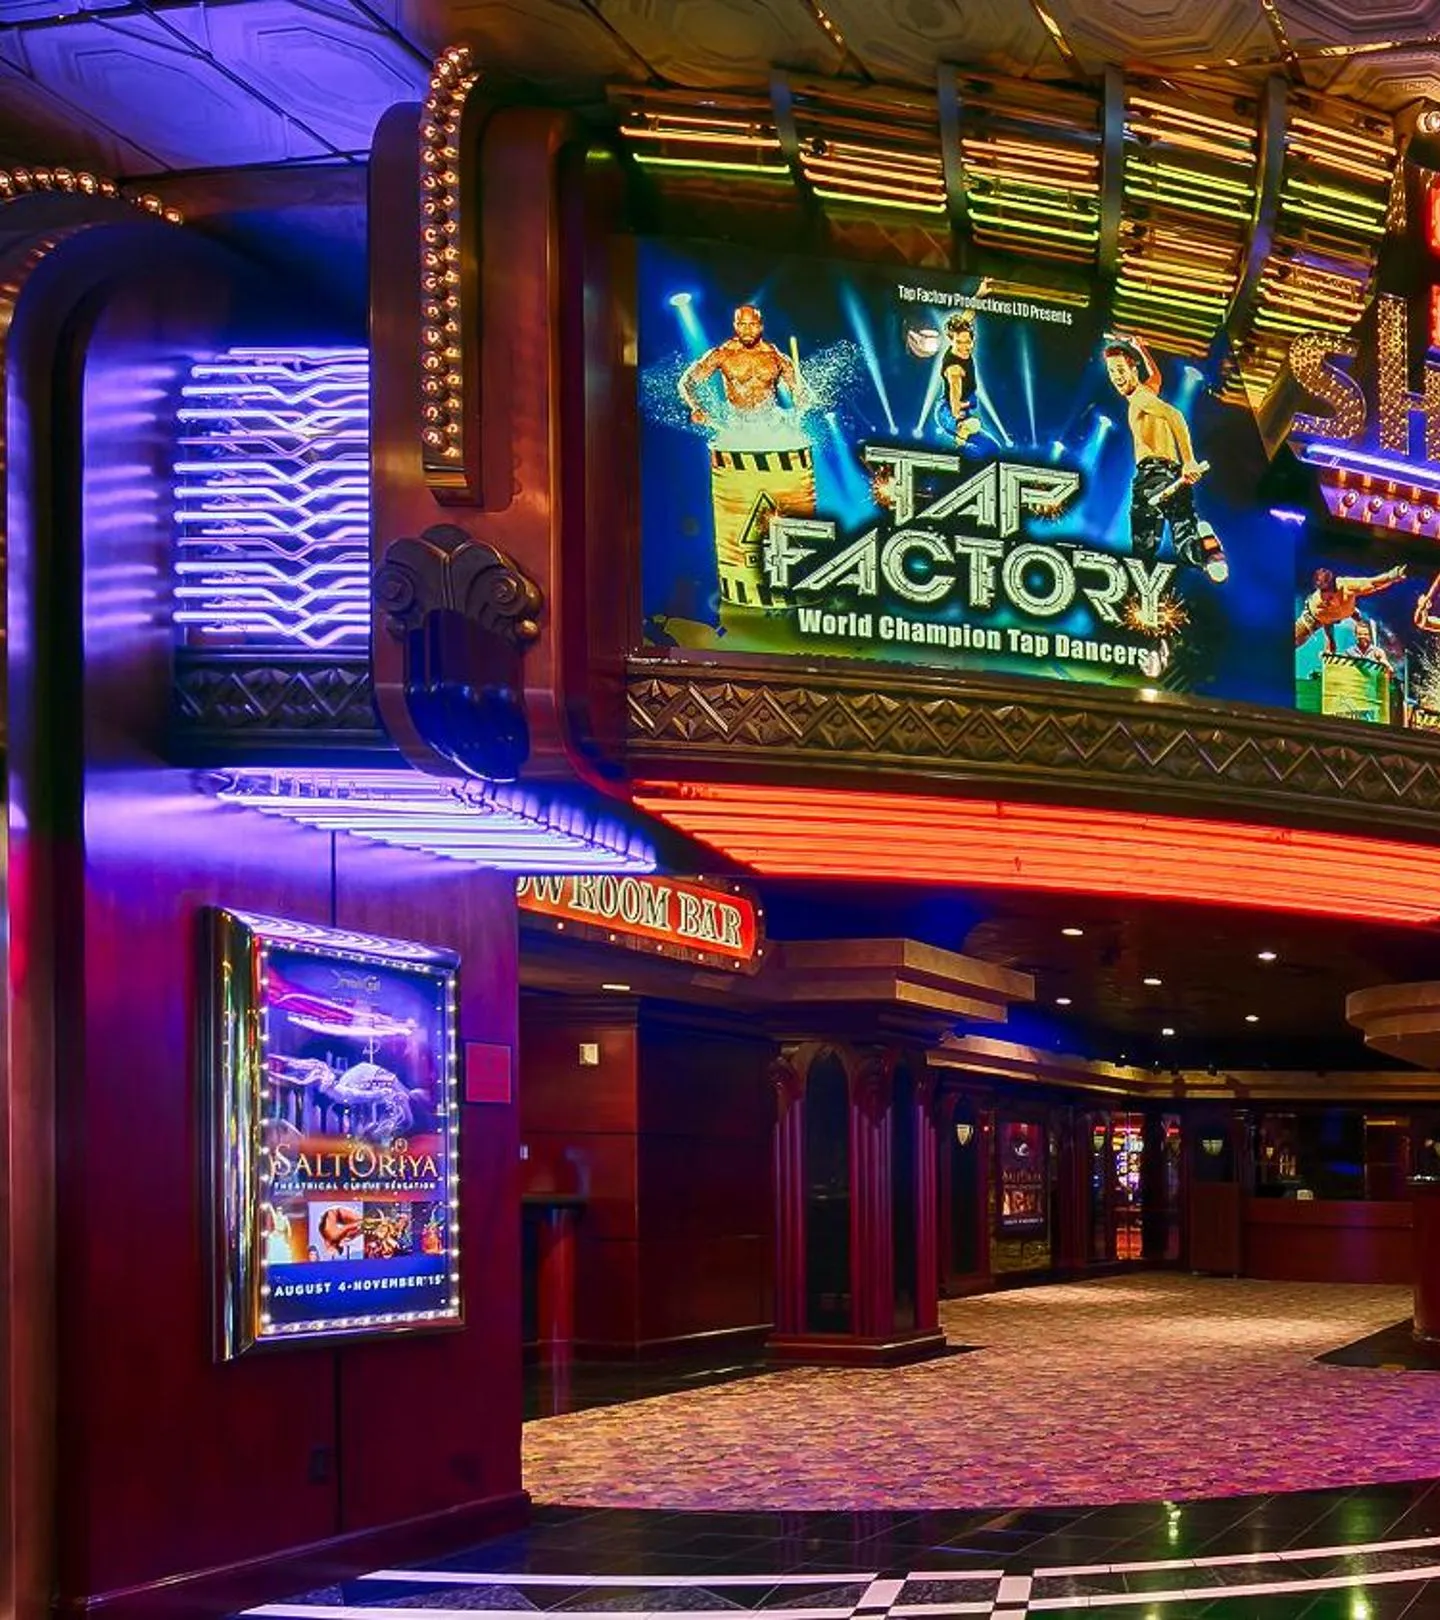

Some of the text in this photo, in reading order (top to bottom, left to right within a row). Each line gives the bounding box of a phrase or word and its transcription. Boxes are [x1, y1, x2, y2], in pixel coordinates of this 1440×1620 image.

[898, 284, 1073, 325] Tap Factory Productions LTD Presents
[863, 444, 1081, 539] TAP
[763, 515, 1178, 628] FACTORY
[798, 607, 1149, 668] World Champion Tap Dancers
[677, 891, 743, 949] BAR
[268, 1138, 439, 1181] SALTORIYA
[274, 1281, 332, 1298] AUGUST
